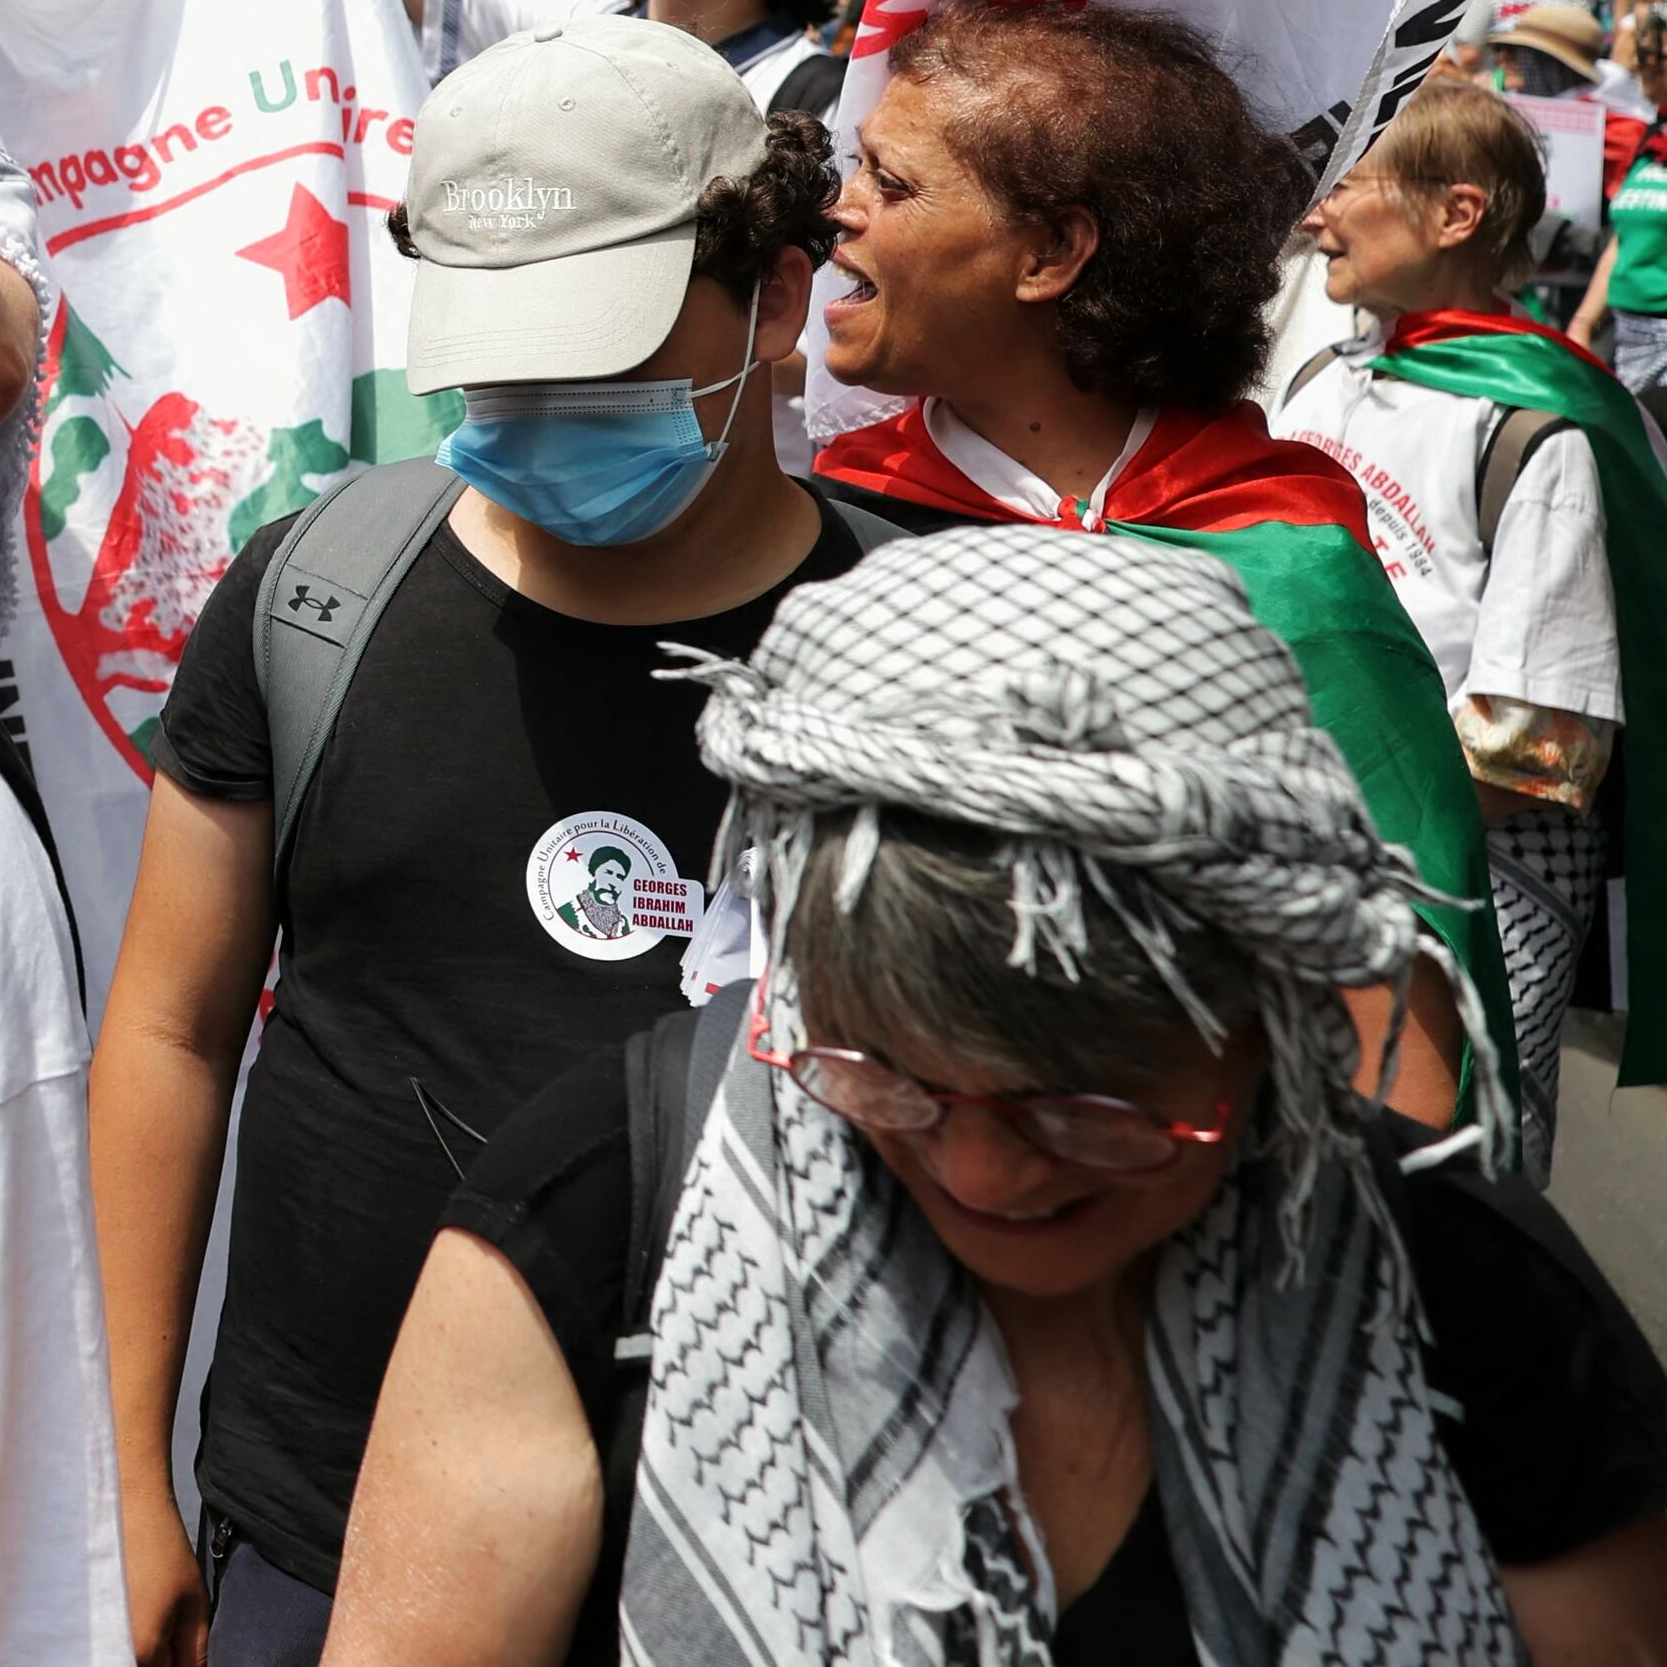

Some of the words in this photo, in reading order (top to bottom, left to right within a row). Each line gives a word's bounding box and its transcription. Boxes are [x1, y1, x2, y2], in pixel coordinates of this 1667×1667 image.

[441, 177, 576, 220] Brooklyn
[469, 214, 495, 230] New
[500, 213, 537, 230] York
[1368, 498, 1409, 541] depuis
[573, 820, 598, 836] pour
[600, 819, 610, 830] la
[537, 828, 572, 863] Unitaire
[613, 820, 660, 861] Libération
[656, 860, 667, 874] de
[538, 865, 555, 921] Campagne
[633, 878, 688, 897] GEORGES
[632, 896, 686, 914] IBRAHIM
[632, 913, 694, 933] ABDALLAH
